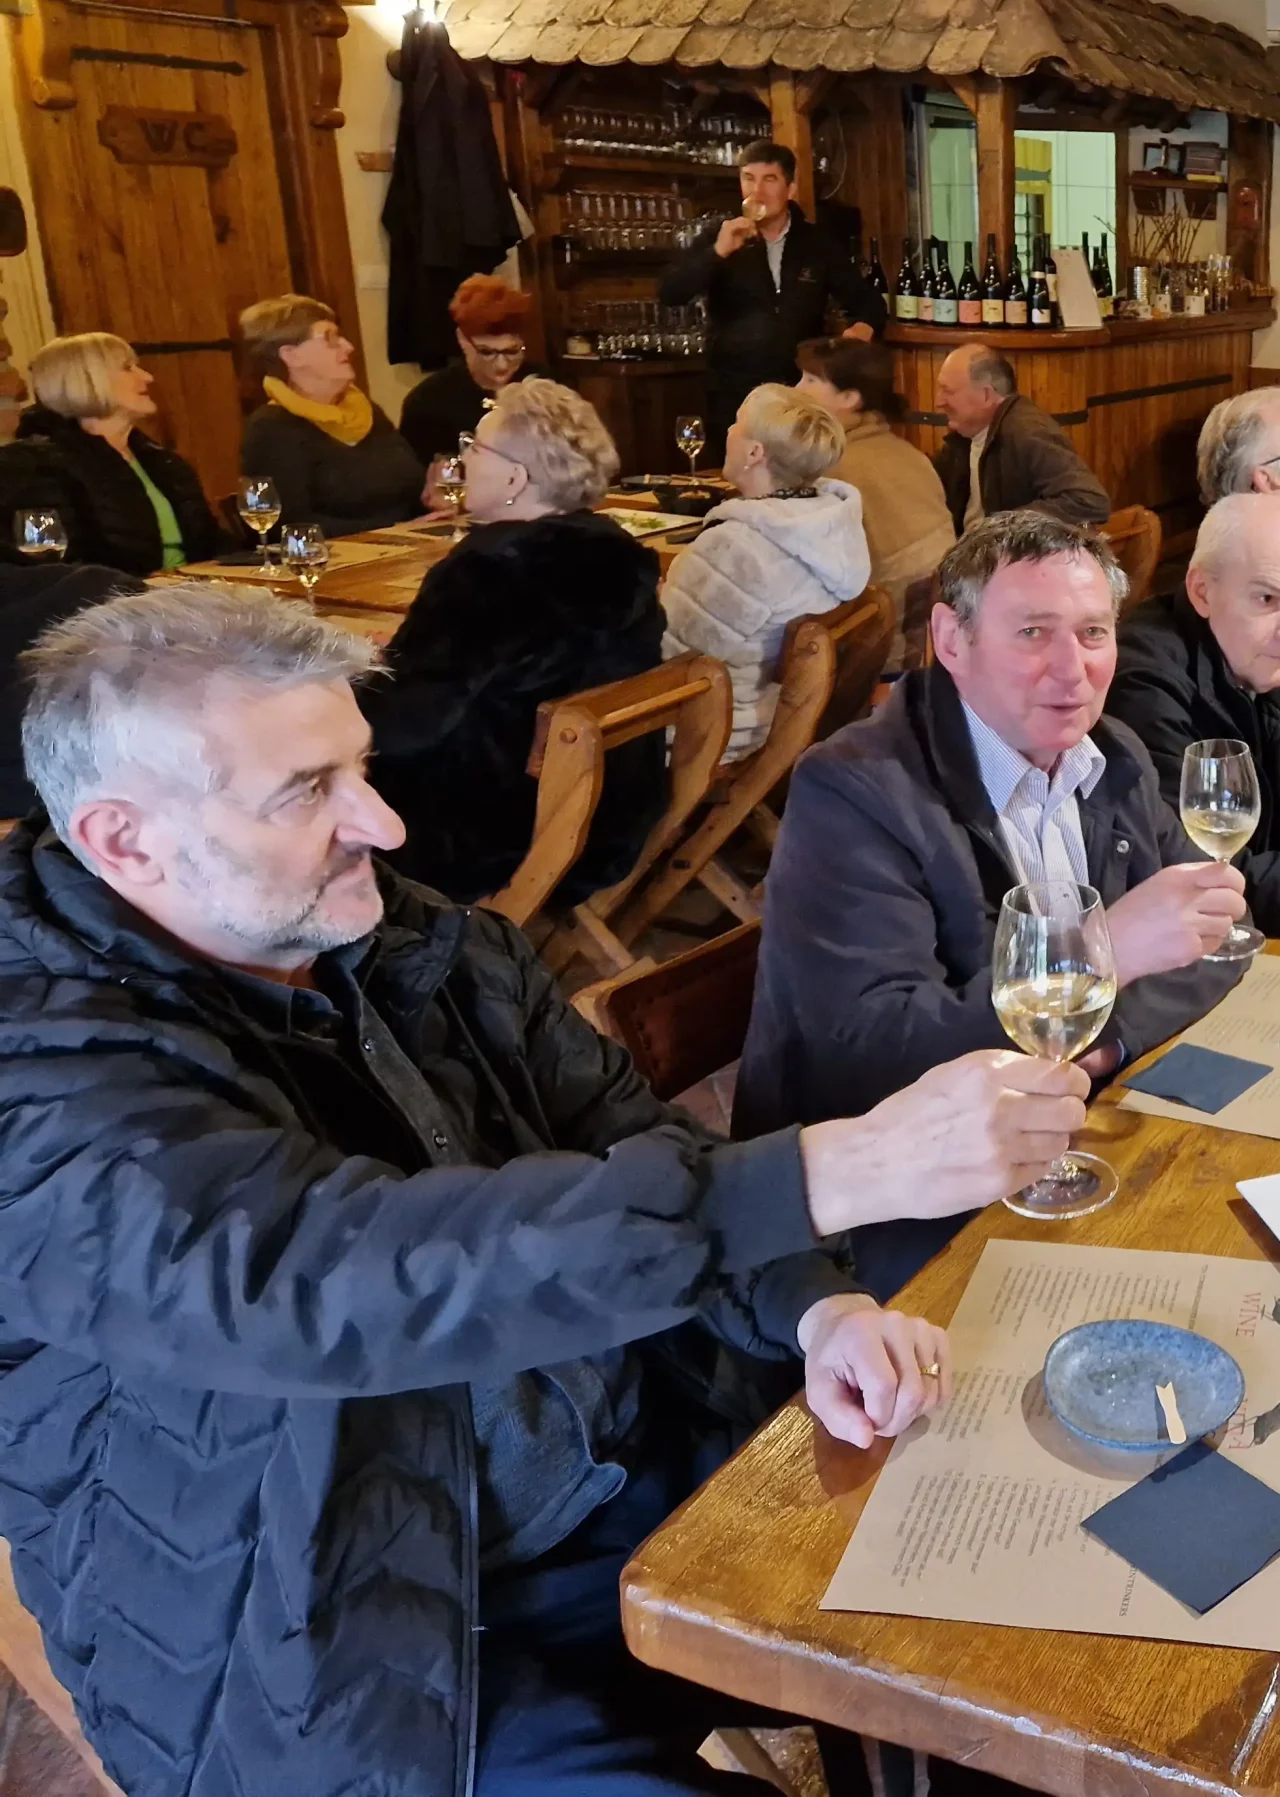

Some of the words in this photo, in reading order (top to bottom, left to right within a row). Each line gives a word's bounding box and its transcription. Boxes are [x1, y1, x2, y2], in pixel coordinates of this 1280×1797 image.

[138, 117, 206, 154] WC
[1235, 1292, 1262, 1337] WINE
[1119, 1563, 1137, 1617] EINTRINKERS
